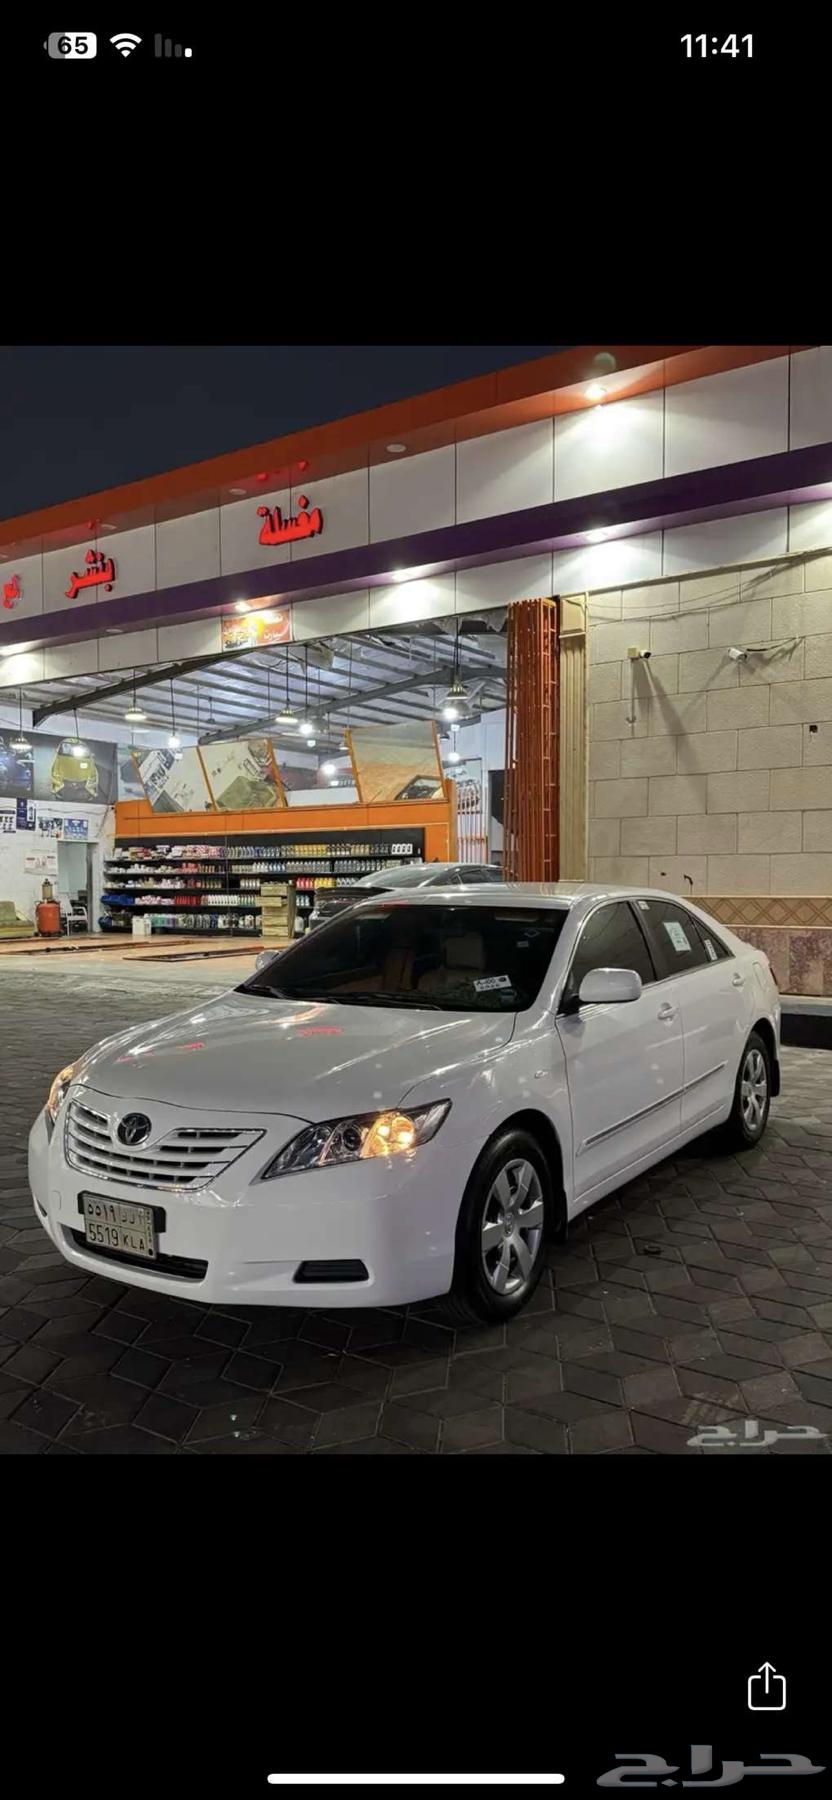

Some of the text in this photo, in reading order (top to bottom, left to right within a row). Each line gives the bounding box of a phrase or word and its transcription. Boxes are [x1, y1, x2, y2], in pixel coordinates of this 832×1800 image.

[257, 495, 323, 546] مغسلة
[65, 549, 115, 599] بنشر
[88, 1203, 116, 1223] ٥٥١٩
[89, 1223, 145, 1251] 5519 KLA
